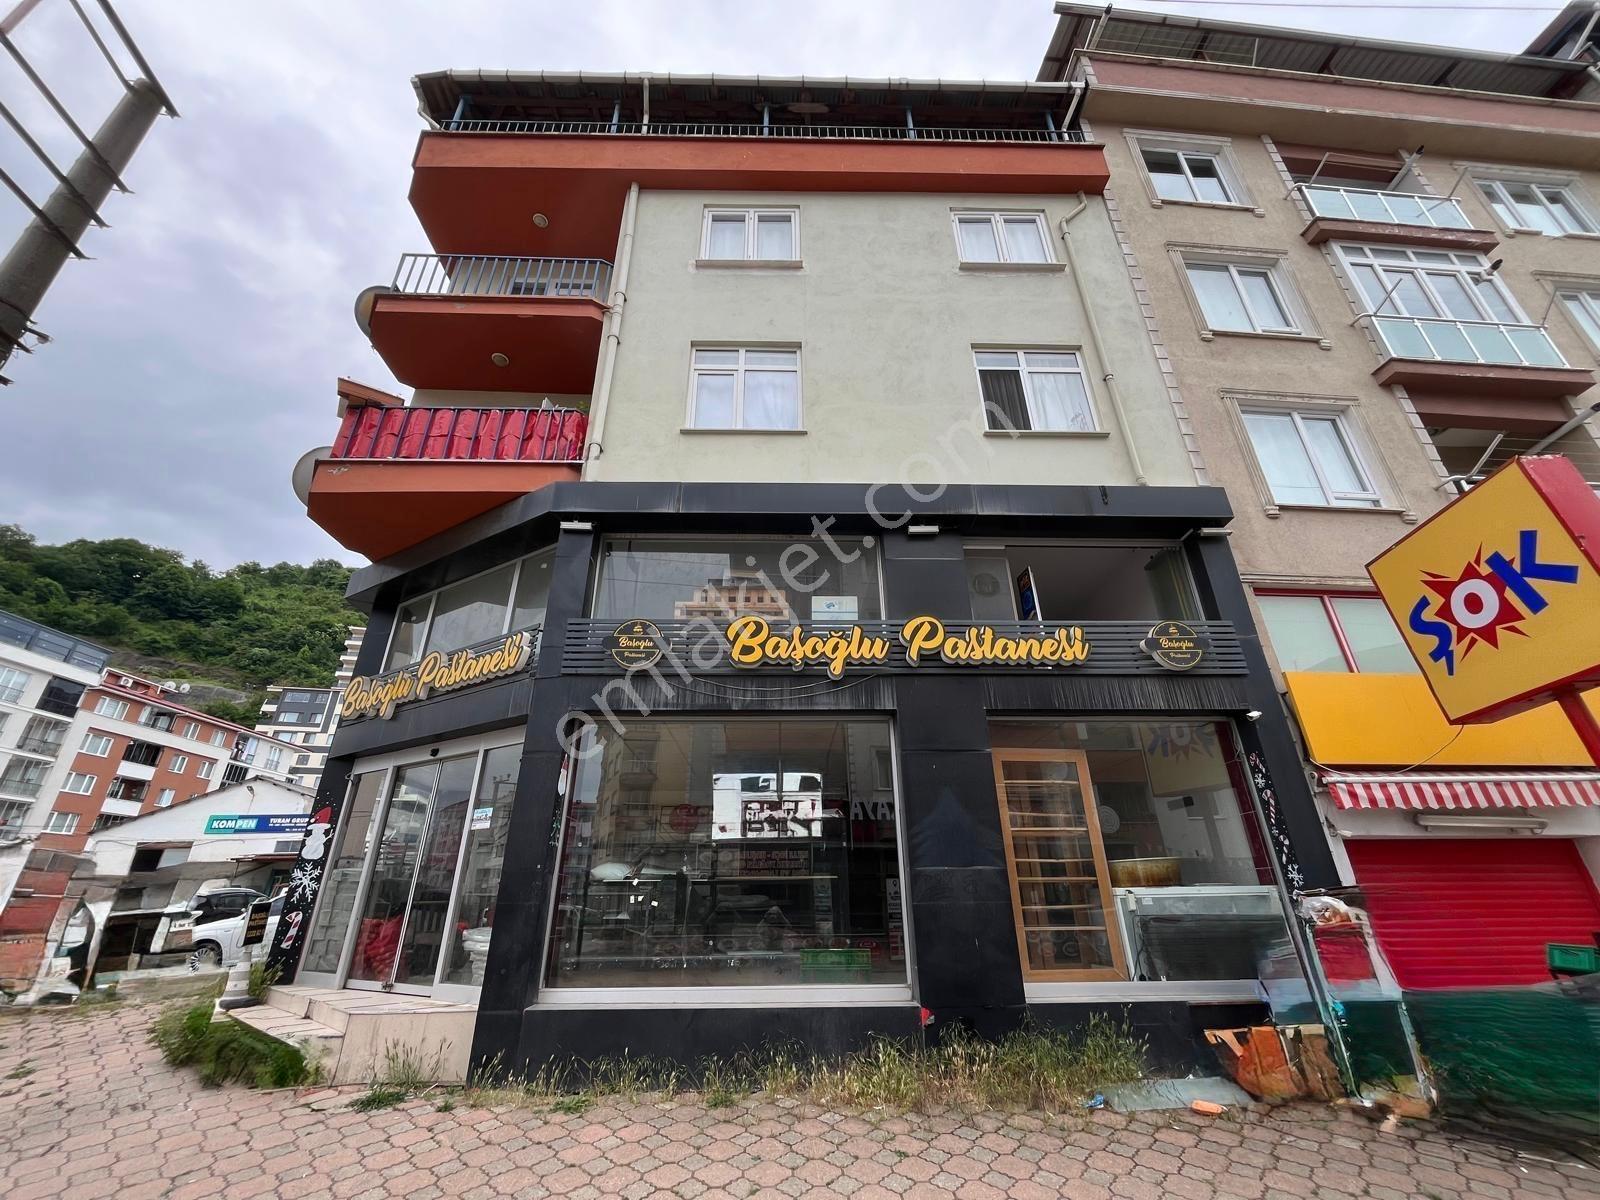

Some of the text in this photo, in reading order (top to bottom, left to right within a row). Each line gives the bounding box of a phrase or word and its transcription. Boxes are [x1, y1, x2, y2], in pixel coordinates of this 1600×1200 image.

[1409, 530, 1579, 676] ŞOK
[341, 633, 525, 718] Başoğlu Pastanesi
[727, 615, 1090, 676] Başoğlu Pastanesi
[211, 818, 257, 829] KOMPEN
